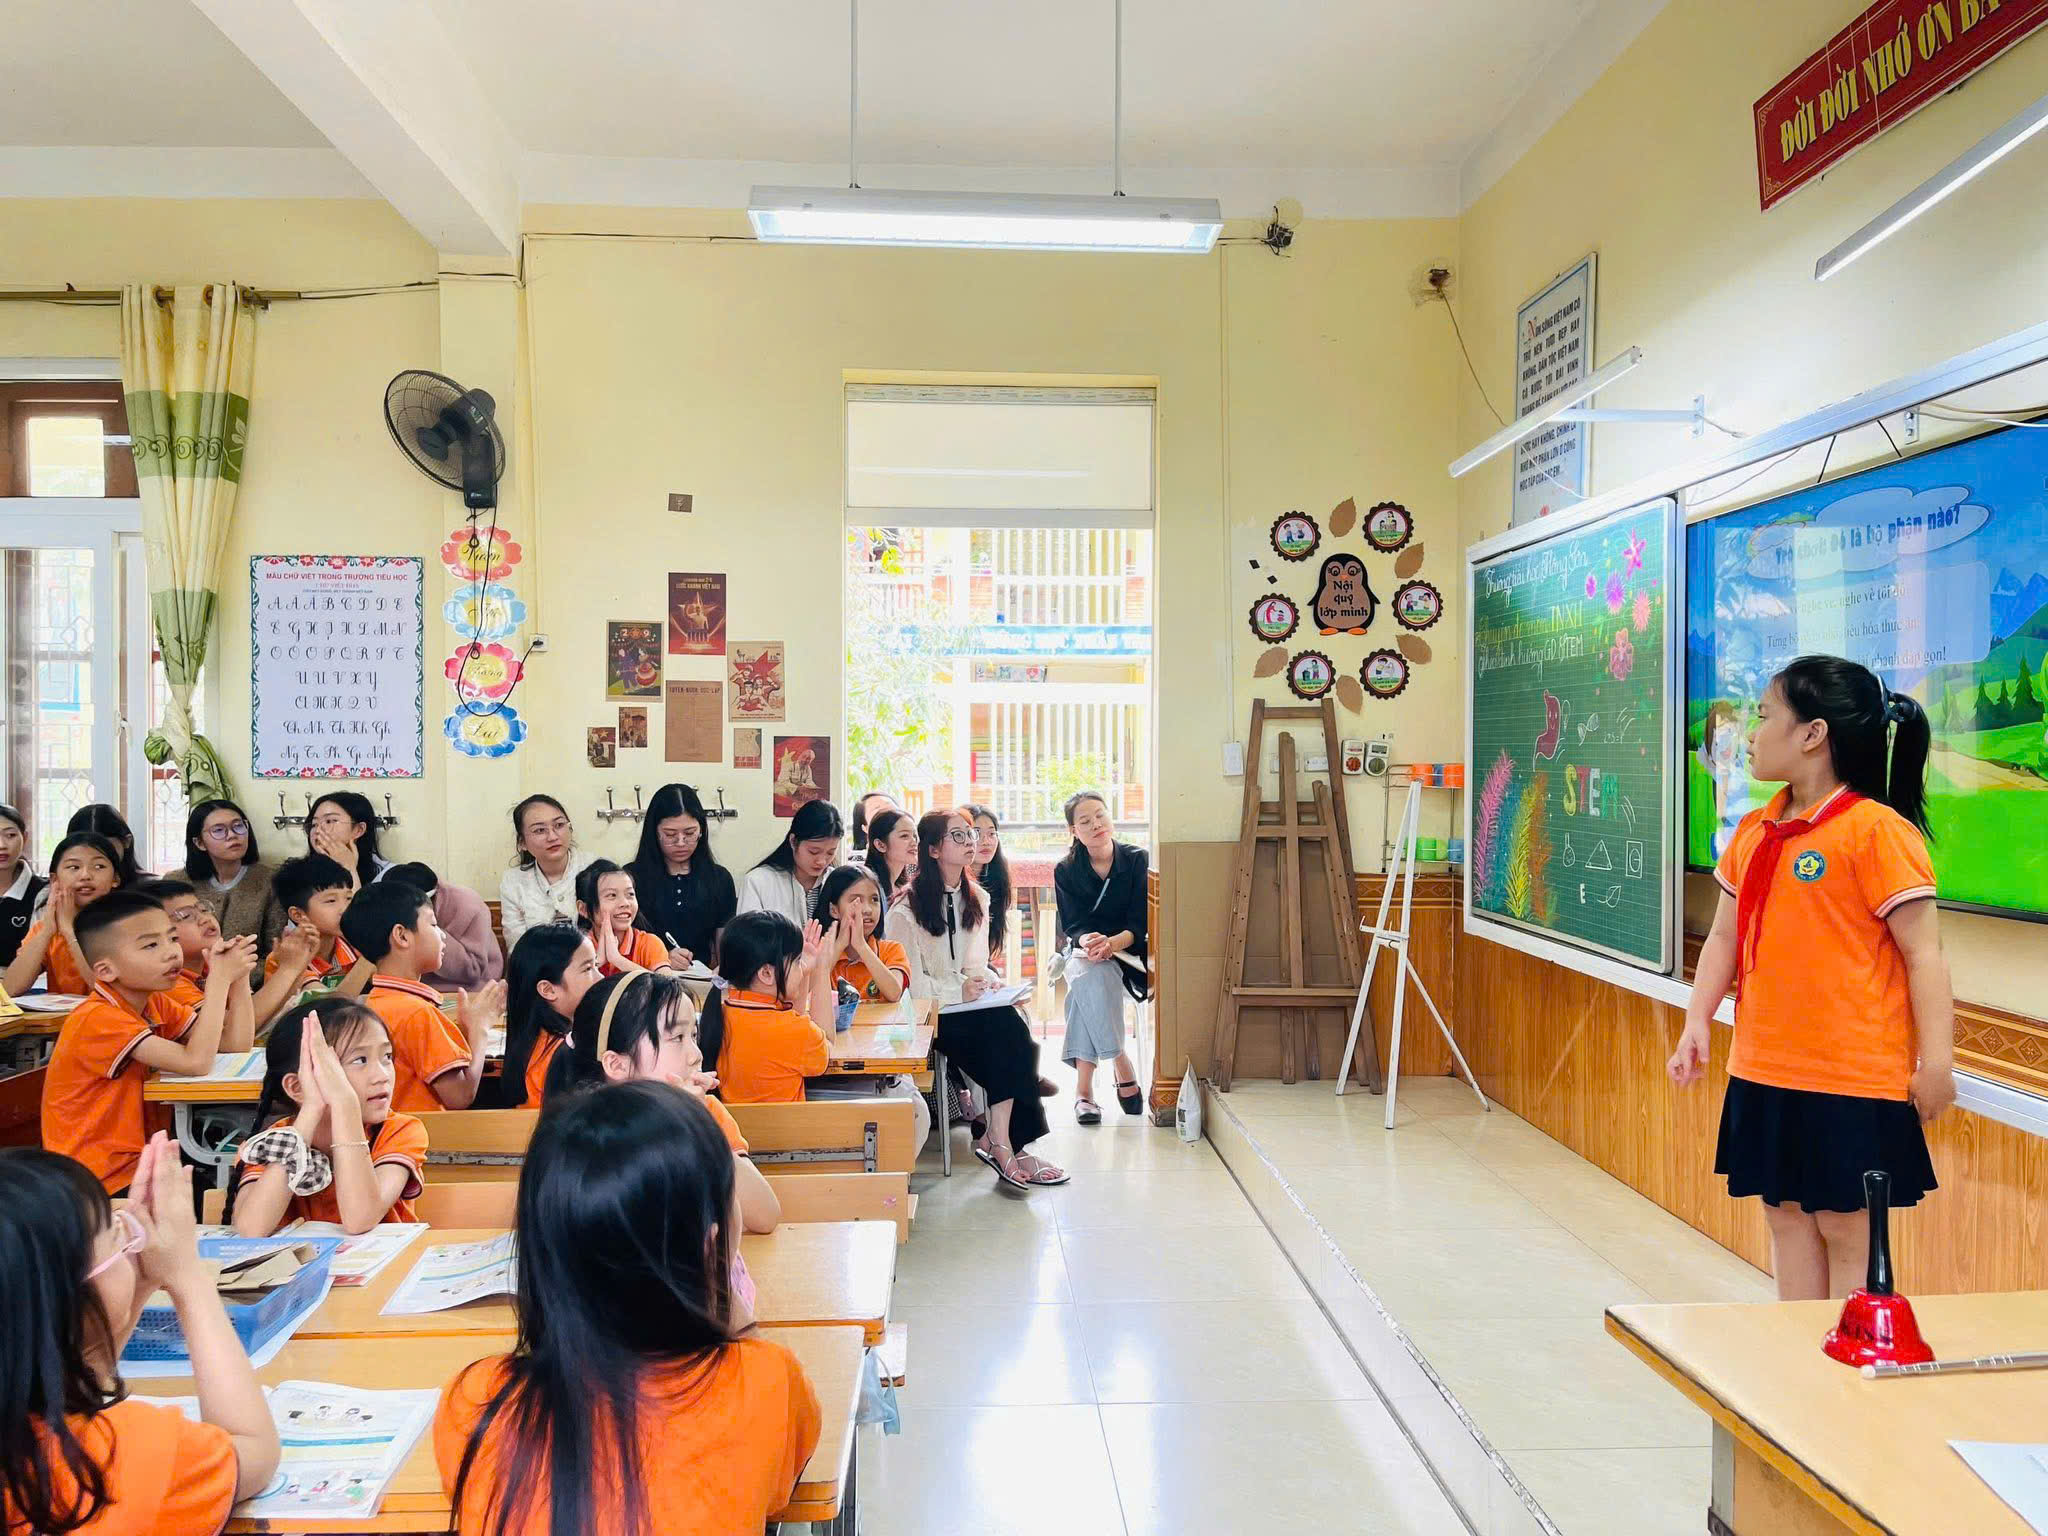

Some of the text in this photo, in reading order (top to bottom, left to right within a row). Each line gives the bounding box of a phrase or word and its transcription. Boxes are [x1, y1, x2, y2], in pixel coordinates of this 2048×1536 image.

[1779, 95, 1817, 163] ĐỜI
[1819, 63, 1861, 134] ĐỜI
[1861, 15, 1912, 103] NHỚ
[1917, 2, 1953, 61] ƠN
[1850, 526, 1863, 549] là
[1866, 523, 1884, 547] bộ
[1887, 515, 1923, 545] phận
[1926, 502, 1961, 531] nào?
[318, 572, 342, 581] TRONG
[1333, 580, 1353, 593] Nội
[1320, 606, 1368, 620] lớp mình
[1562, 763, 1619, 820] STEM
